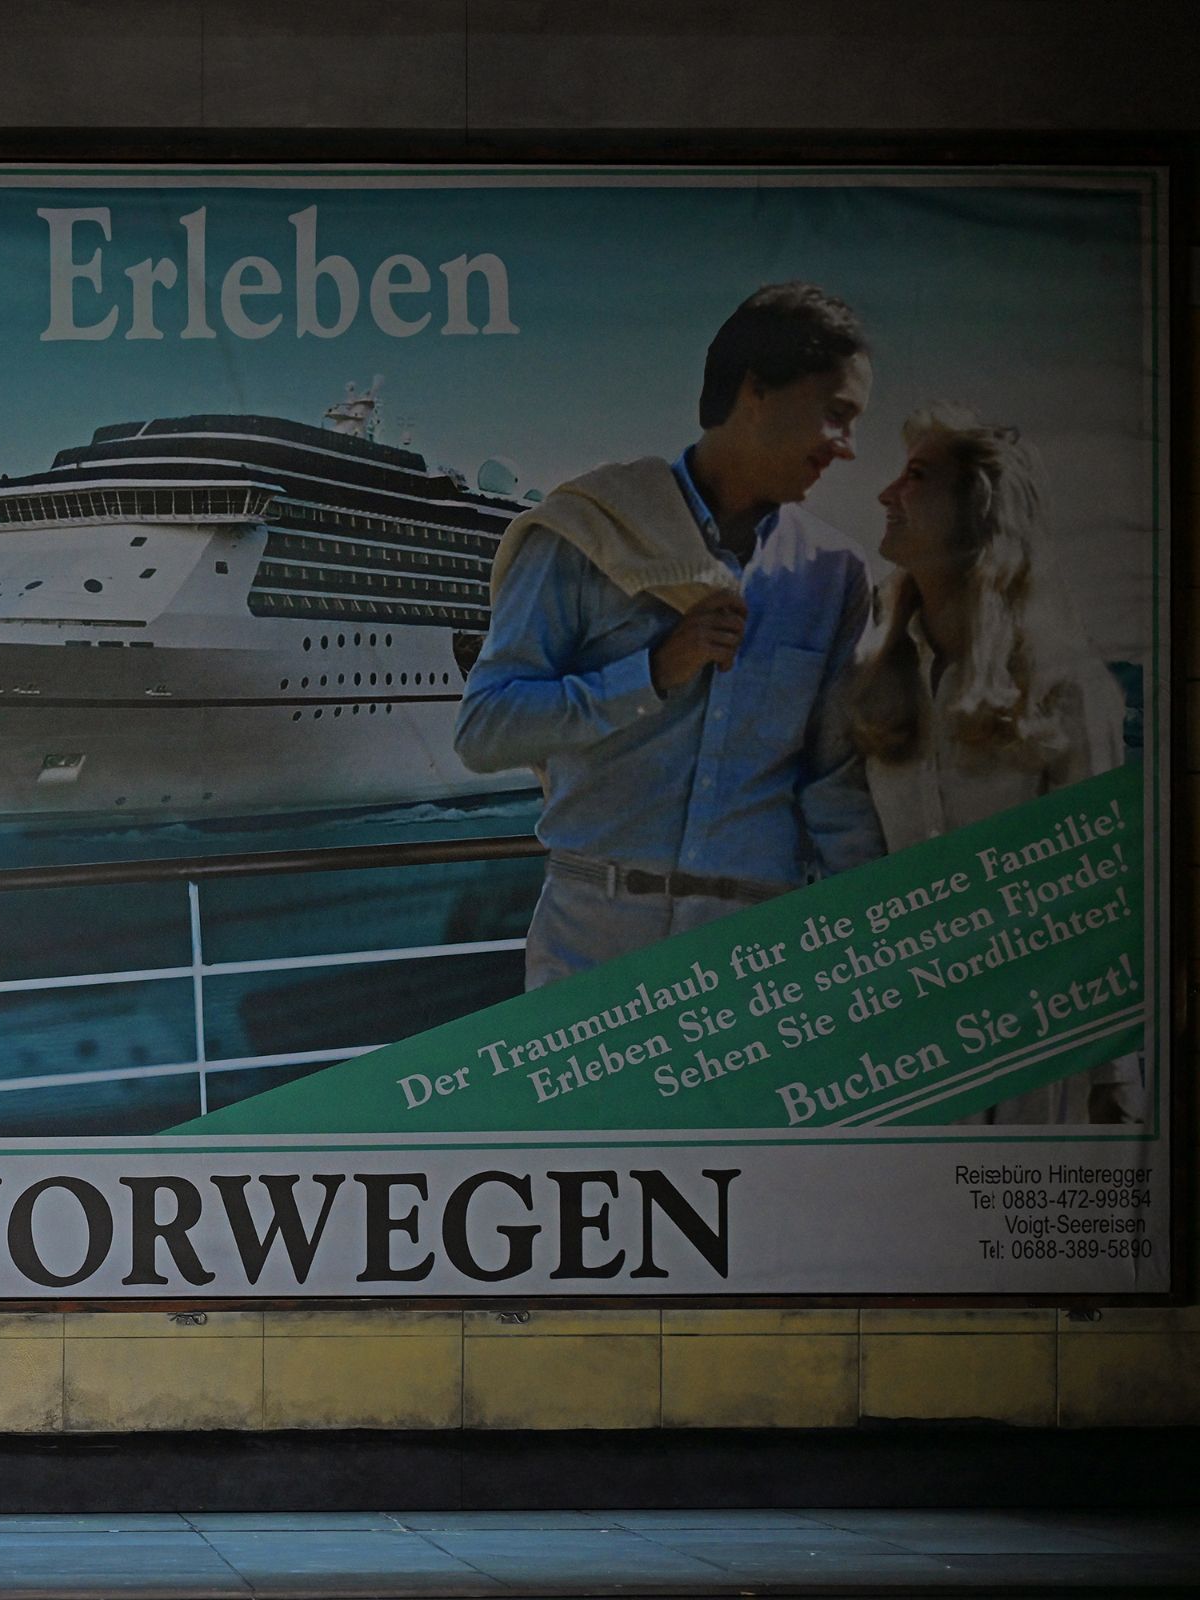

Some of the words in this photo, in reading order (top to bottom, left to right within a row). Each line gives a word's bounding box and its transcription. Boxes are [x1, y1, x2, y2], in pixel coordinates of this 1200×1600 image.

[36, 203, 520, 343] Erleben
[396, 1066, 470, 1110] Der
[477, 961, 719, 1077] Traumurlaub
[729, 941, 787, 980] für
[800, 914, 854, 952] die
[865, 871, 971, 934] ganze
[975, 798, 1126, 882] Familie!
[526, 1033, 672, 1104] Erleben
[678, 1006, 736, 1043] Sie
[749, 979, 803, 1017] die
[814, 906, 995, 992] schönsten
[997, 842, 1129, 918] Fjorde!
[654, 1038, 772, 1097] Sehen
[777, 1012, 836, 1049] Sie
[848, 985, 903, 1023] die
[907, 885, 1132, 999] Nordlichter!
[775, 1042, 950, 1127] Buchen
[955, 1008, 1022, 1054] Sie
[1030, 952, 1139, 1038] jetzt!
[955, 1164, 1042, 1185] Reisebüro
[1049, 1165, 1153, 1188] Hinteregger
[1002, 1189, 1152, 1209] 0883-472-99854
[1004, 1214, 1146, 1239] Voigt-Seereisen
[1011, 1239, 1152, 1260] 0688-389-5890
